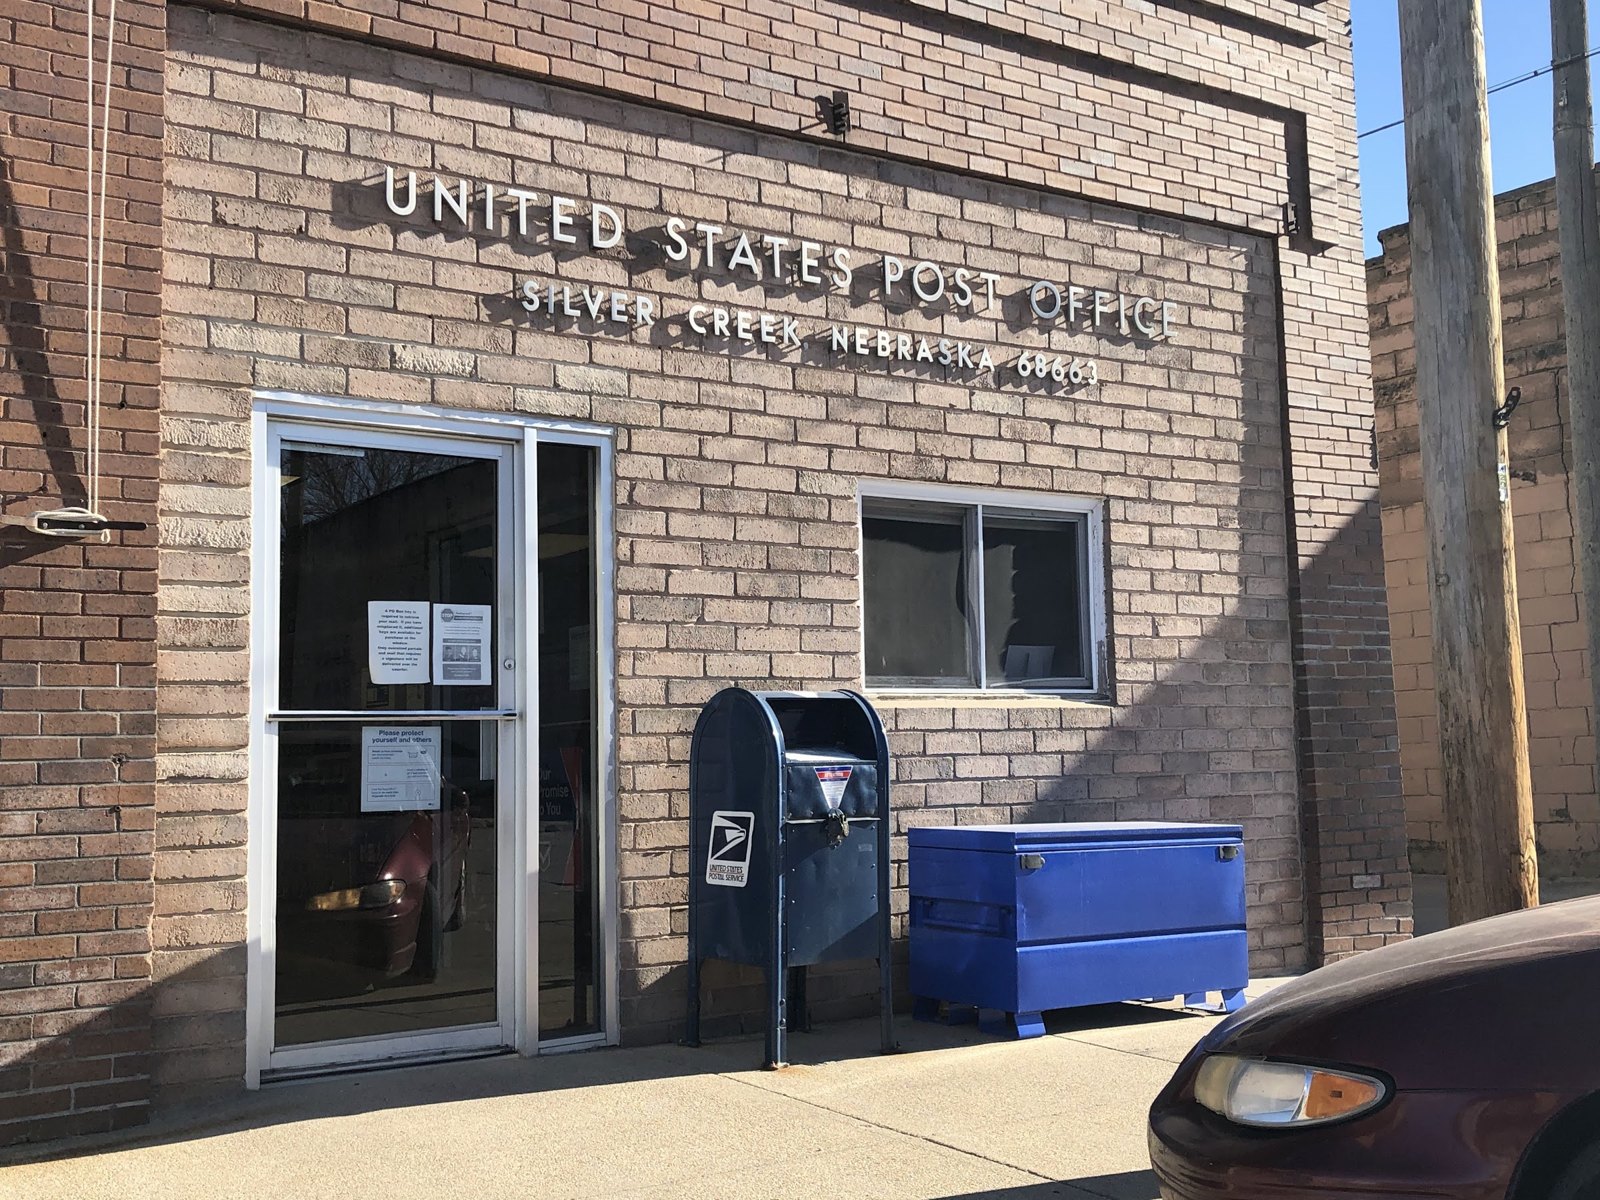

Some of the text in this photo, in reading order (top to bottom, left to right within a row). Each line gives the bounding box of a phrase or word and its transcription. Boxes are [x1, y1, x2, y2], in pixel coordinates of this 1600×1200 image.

[384, 166, 1179, 338] UNITED STATES POST OFFICE
[521, 280, 654, 326] SILVER
[831, 325, 995, 372] NEBRASKA
[1017, 350, 1098, 386] 68663
[539, 784, 569, 798] romise
[546, 801, 561, 816] You
[710, 864, 743, 873] UNITED STATES
